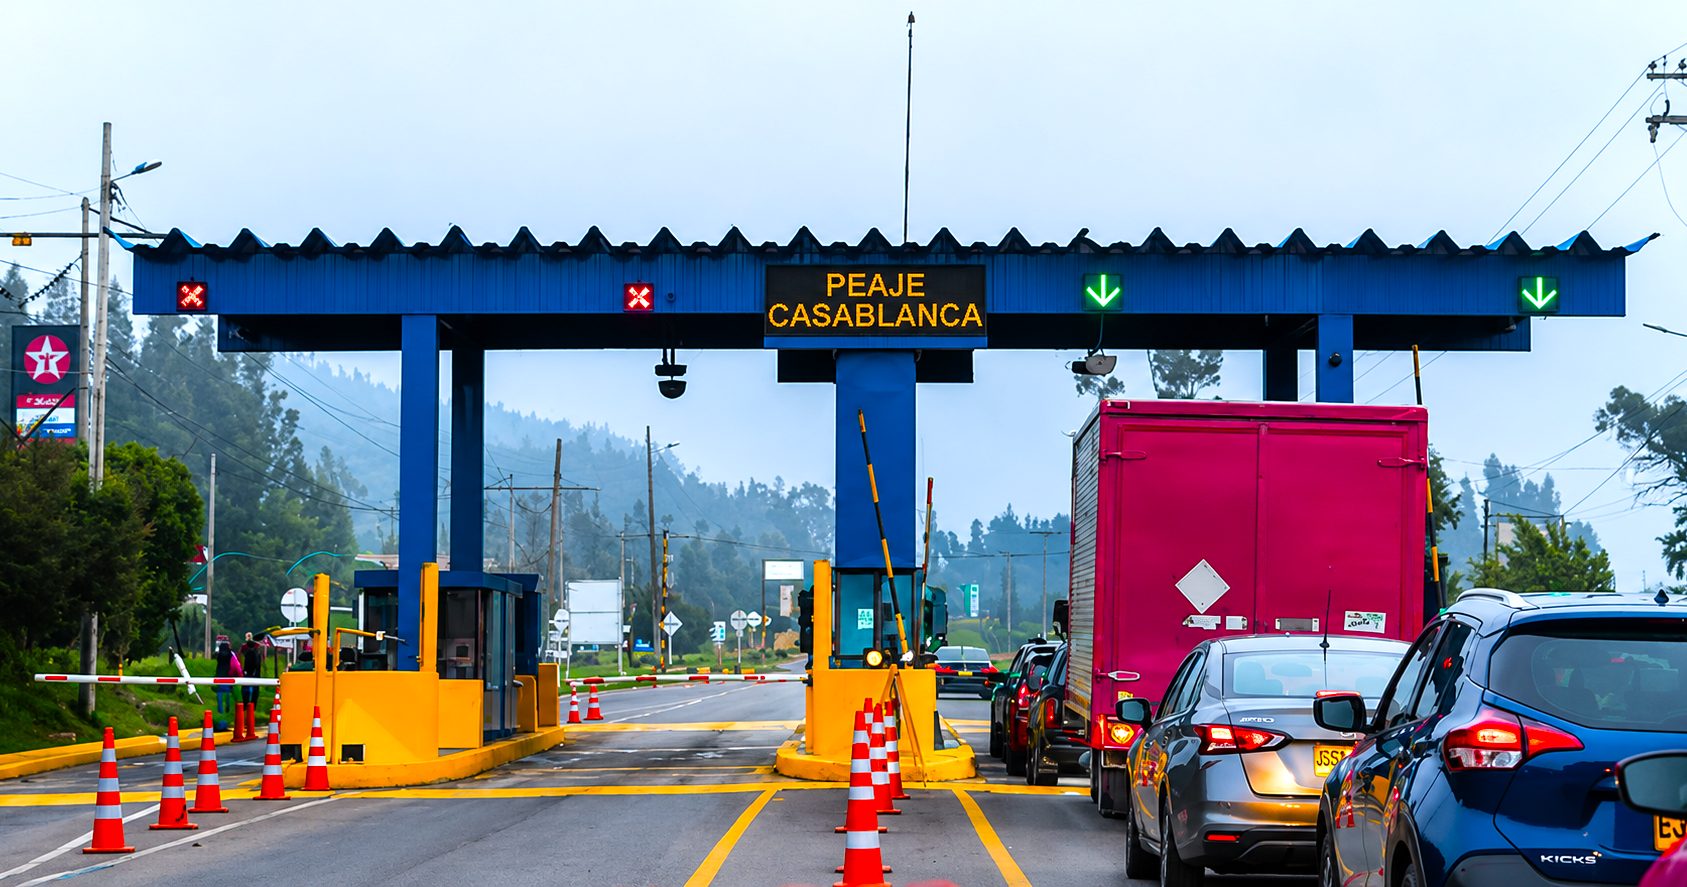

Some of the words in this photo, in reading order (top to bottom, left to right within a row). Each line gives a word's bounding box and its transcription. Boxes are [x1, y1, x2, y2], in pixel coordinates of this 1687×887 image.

[826, 273, 925, 297] PEAJE
[768, 303, 983, 328] CASABLANCA
[1540, 855, 1597, 865] KICKS
